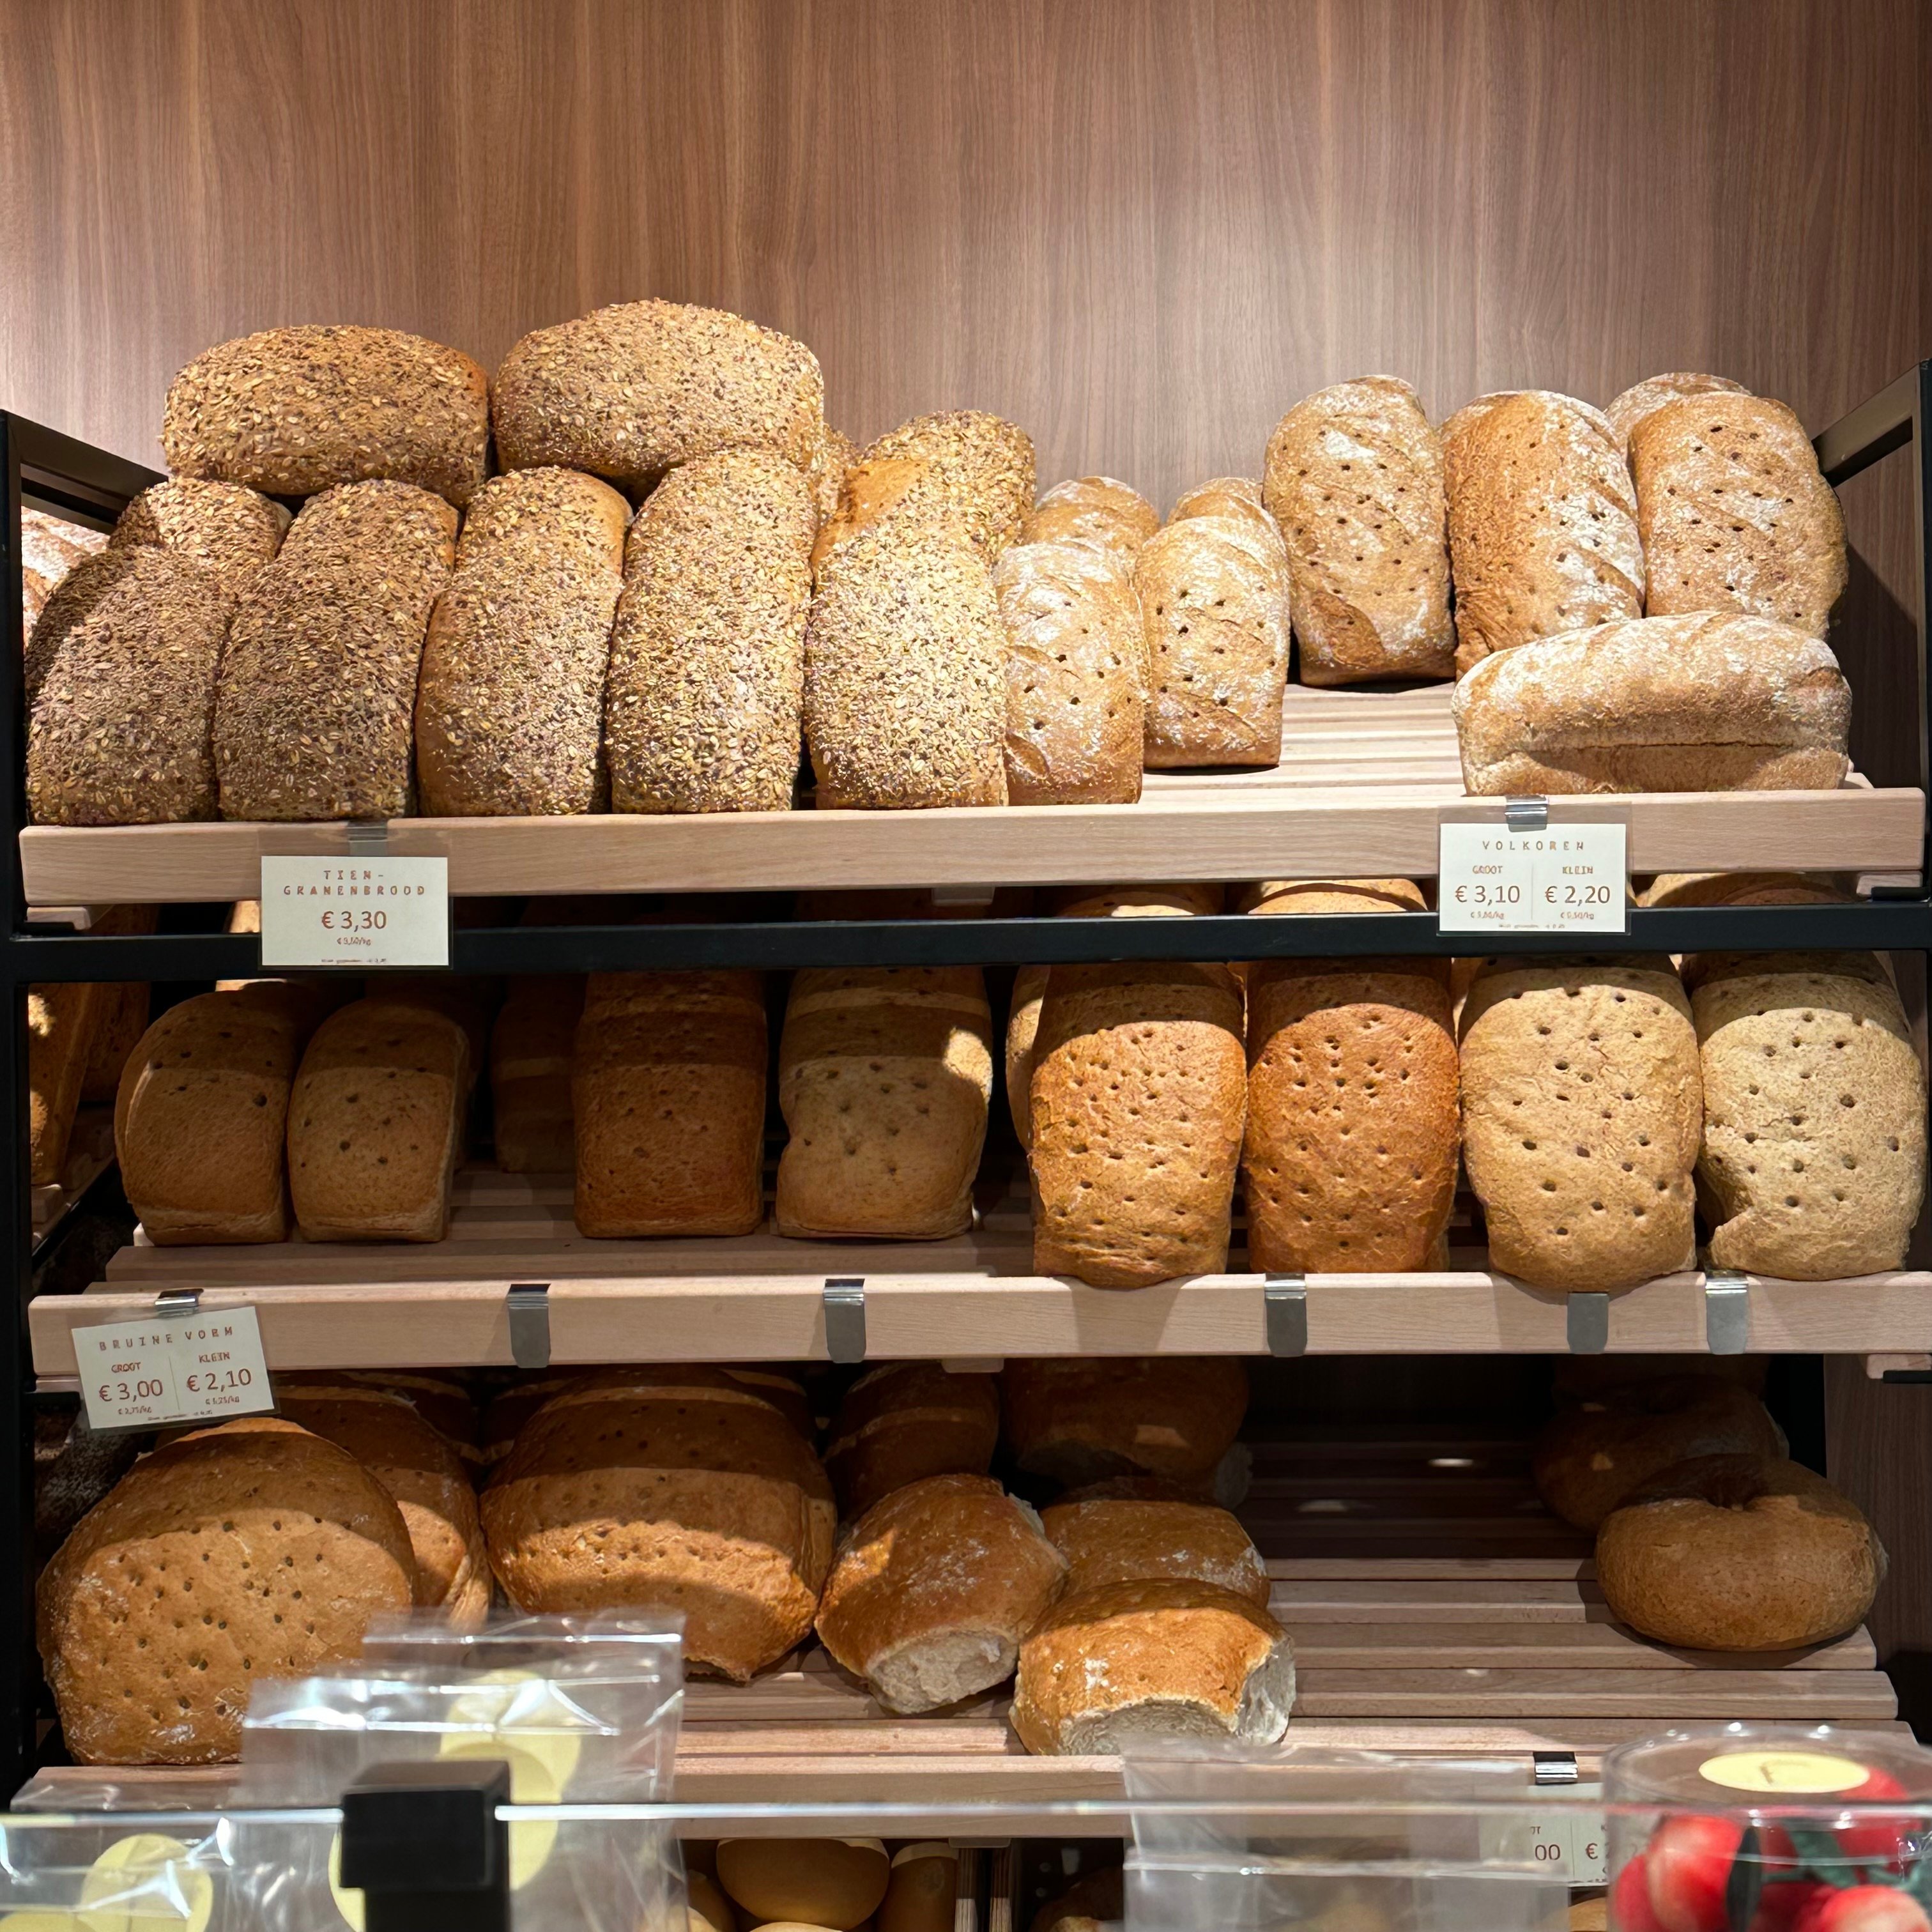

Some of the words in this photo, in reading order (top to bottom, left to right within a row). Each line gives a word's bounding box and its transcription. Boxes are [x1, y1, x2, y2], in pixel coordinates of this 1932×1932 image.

[1482, 841, 1584, 850] VOLKOREN
[323, 870, 383, 880] TIEN-
[1472, 865, 1503, 875] GROOT
[1562, 866, 1593, 875] KLEIN
[284, 885, 425, 895] GRANENBROOD
[99, 1334, 173, 1351] BRUINE
[185, 1326, 233, 1340] VORM
[198, 1352, 230, 1363] KLEIN
[111, 1362, 142, 1373] GROOT
